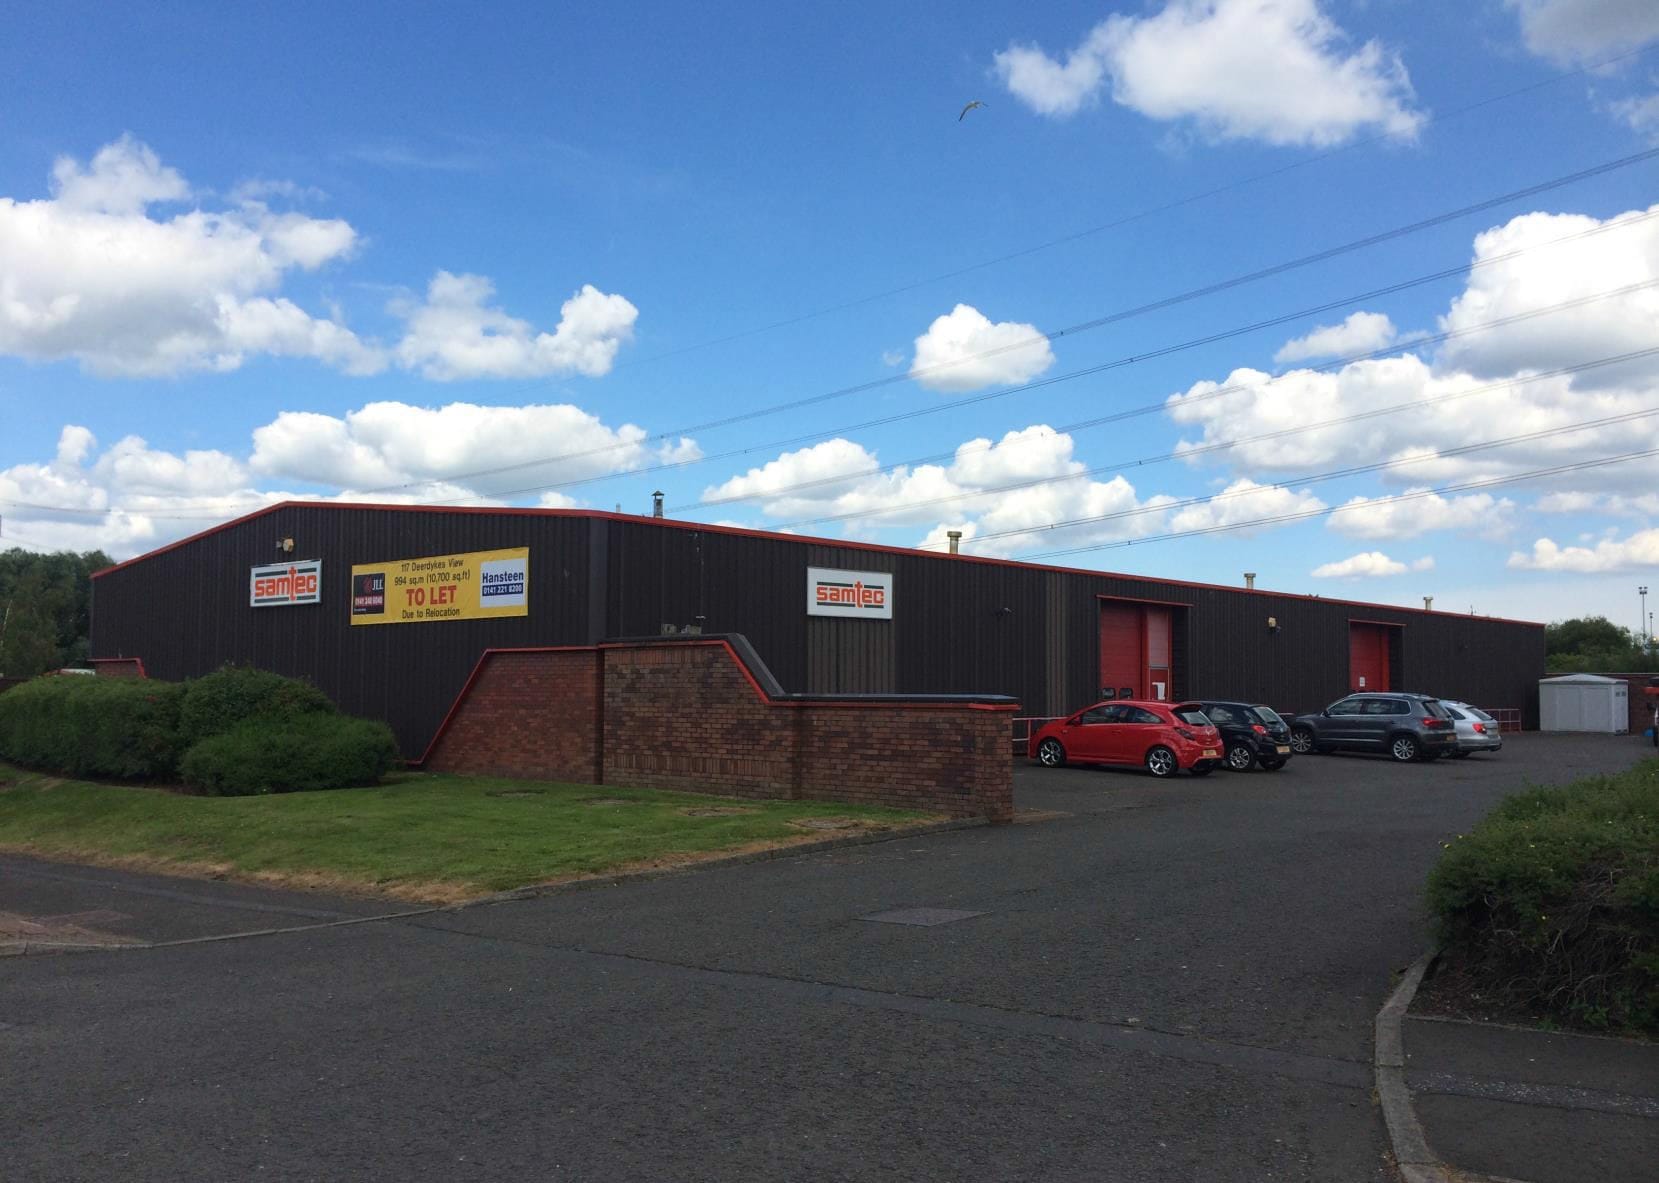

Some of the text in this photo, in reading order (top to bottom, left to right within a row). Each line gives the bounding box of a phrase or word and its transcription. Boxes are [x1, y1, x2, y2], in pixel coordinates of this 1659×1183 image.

[401, 558, 464, 573] 117 Deerdykes View
[255, 566, 317, 601] samtec
[372, 578, 384, 591] JLL
[394, 576, 407, 586] 994
[409, 575, 424, 586] sq.m
[426, 572, 450, 584] (10,700
[482, 571, 524, 584] Hansteen
[406, 585, 457, 607] TO LET
[497, 585, 507, 593] 221
[816, 580, 884, 608] samtec
[402, 607, 460, 619] Due to Relocation
